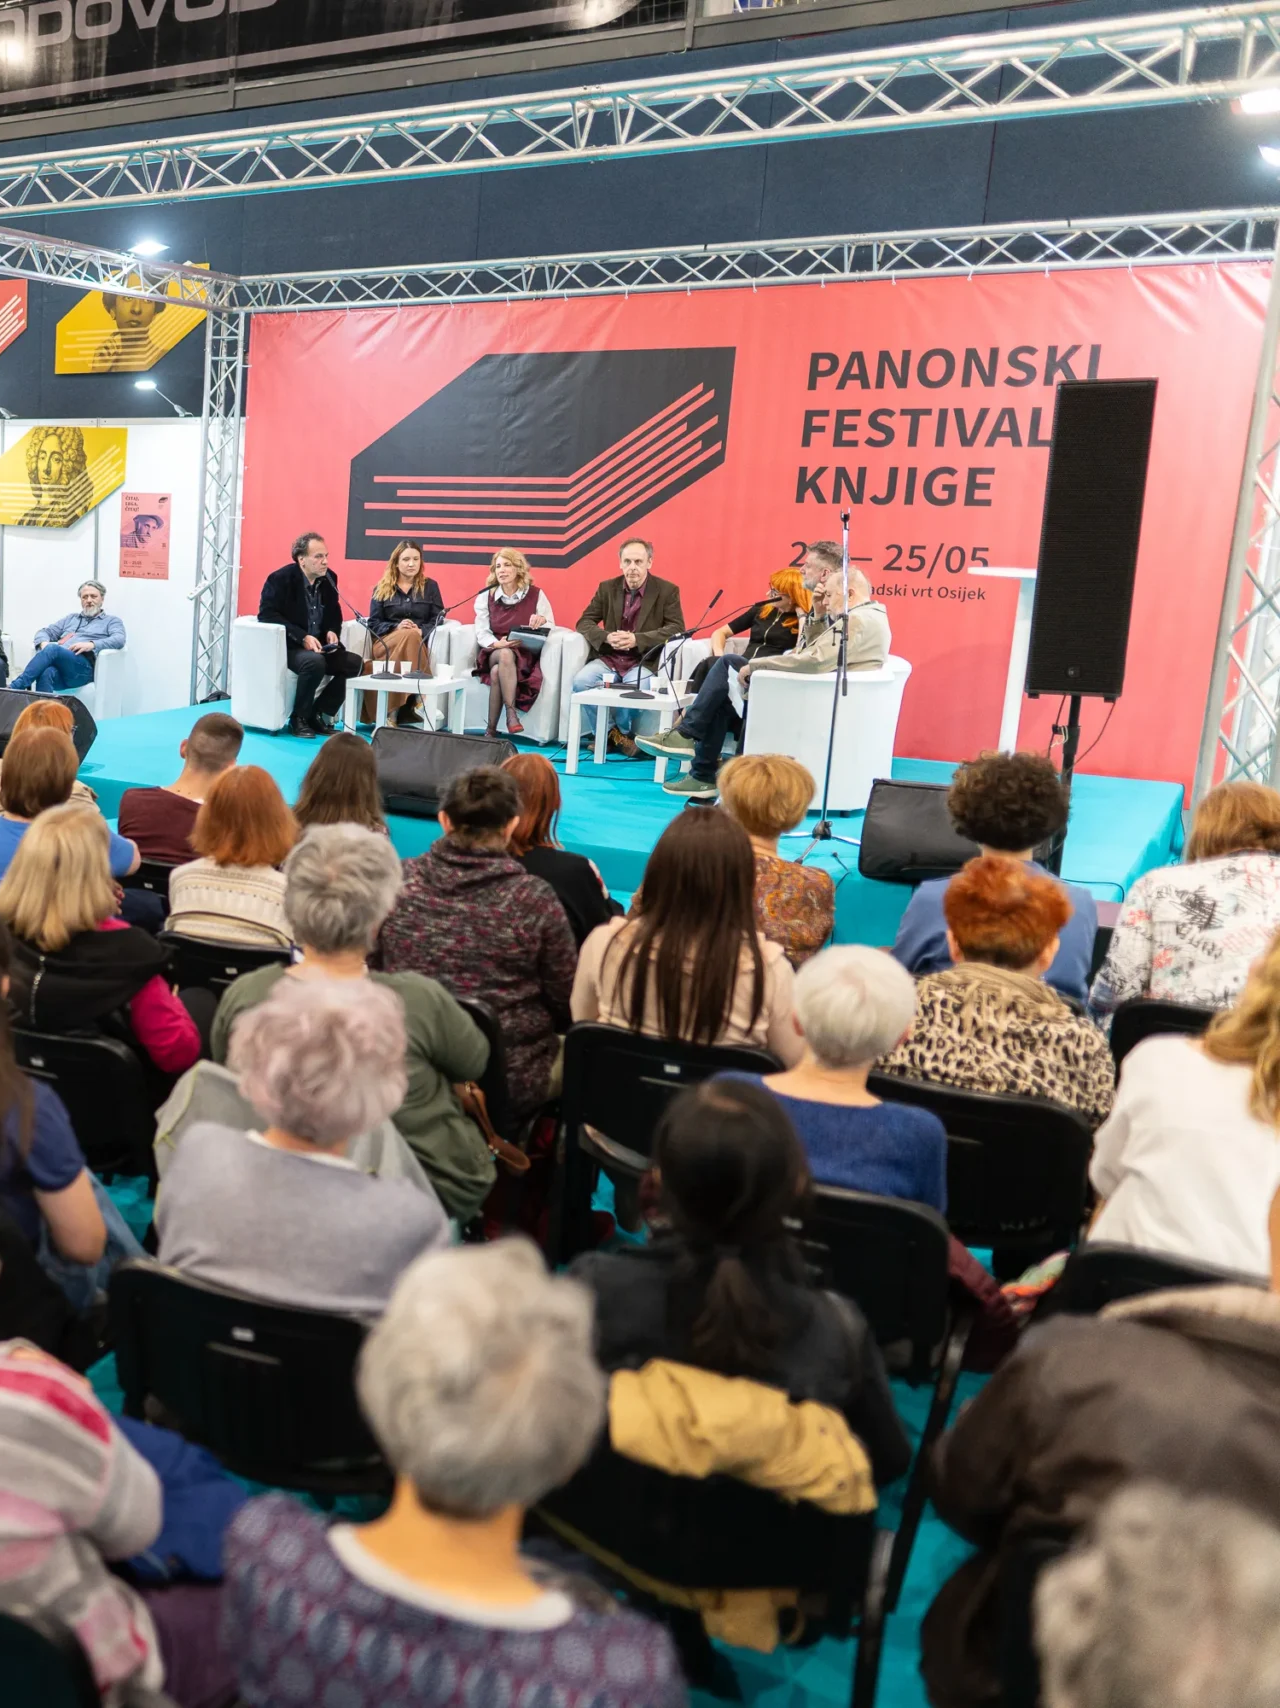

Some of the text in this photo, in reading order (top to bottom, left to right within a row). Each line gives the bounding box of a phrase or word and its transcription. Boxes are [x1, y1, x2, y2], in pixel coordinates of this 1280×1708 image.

[807, 344, 1102, 391] PANONSKI
[801, 407, 1052, 448] FESTIVAL
[795, 466, 995, 507] KNJIGE
[788, 541, 807, 568] 2
[882, 543, 990, 579] 25/05
[871, 584, 986, 603] adski vrt Osijek
